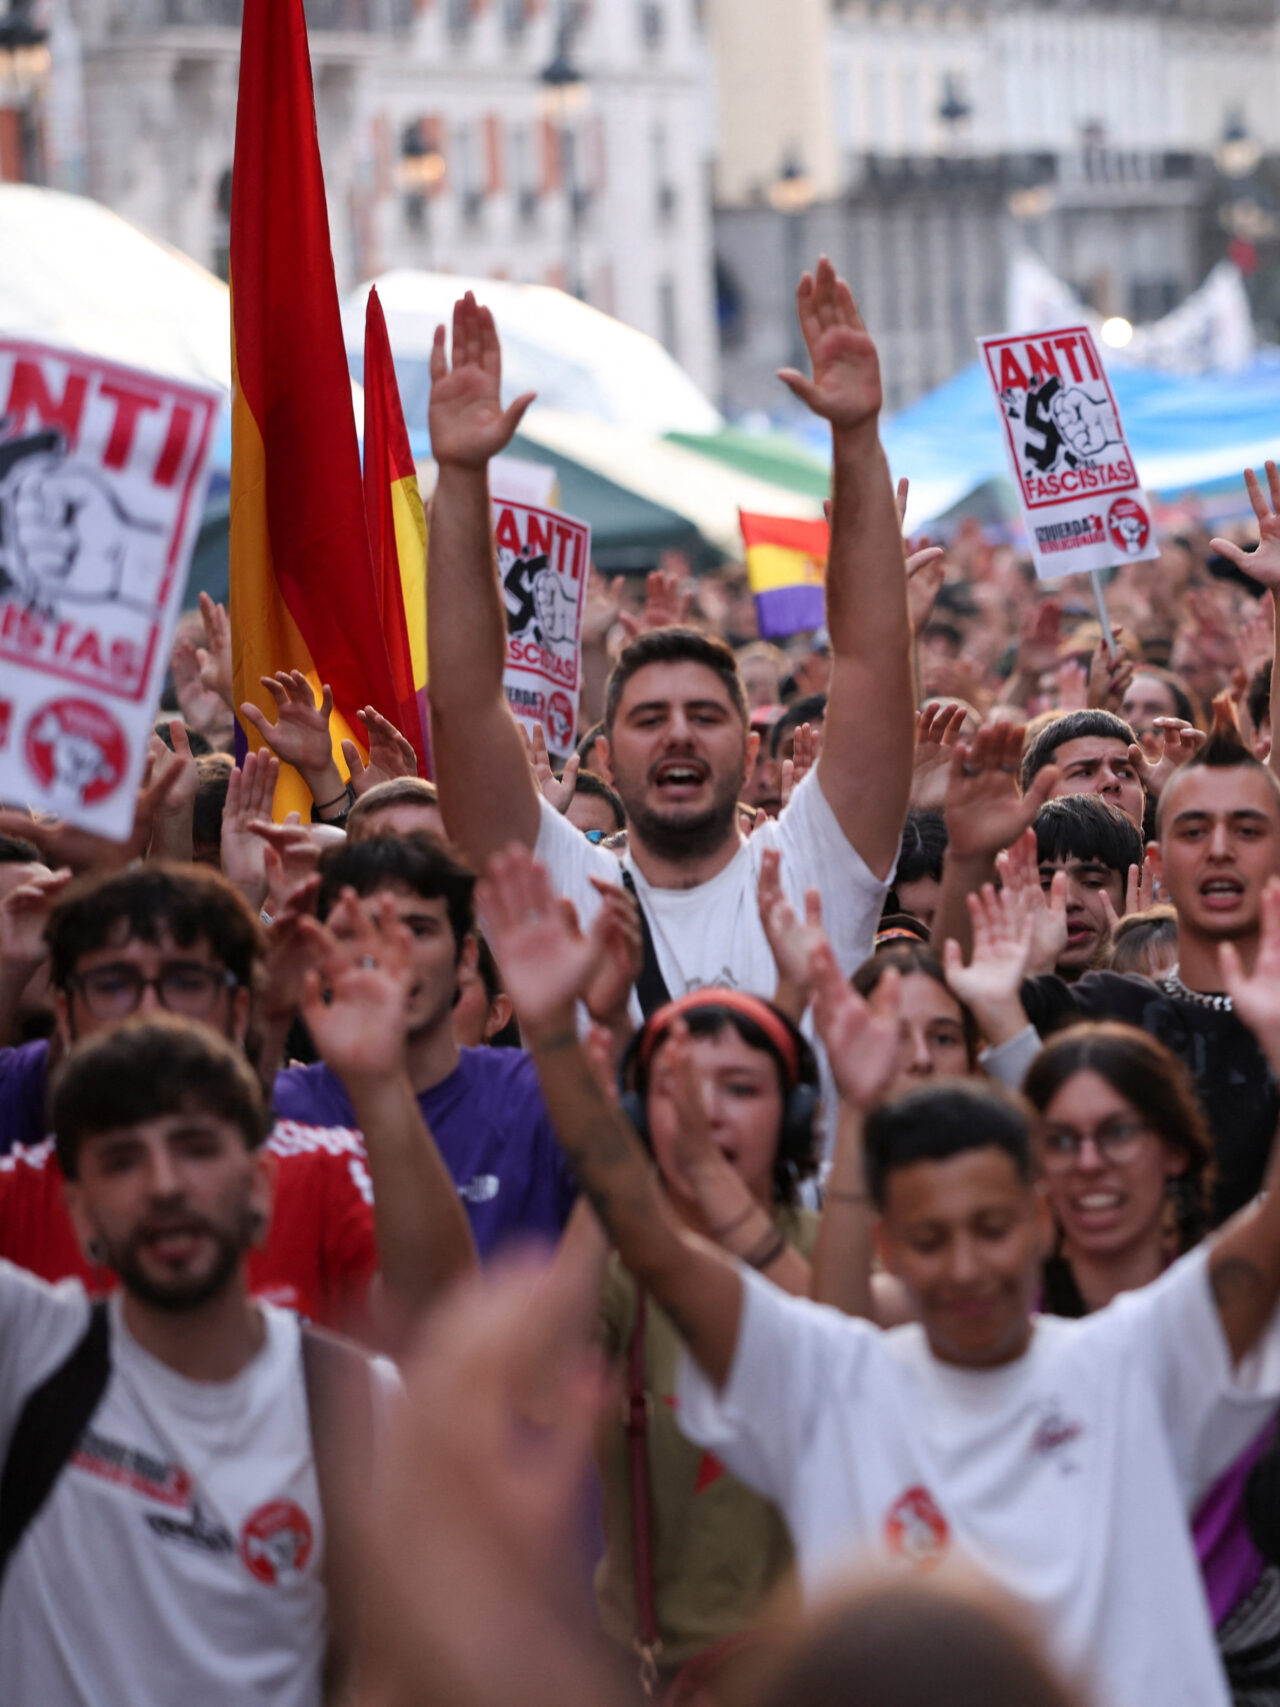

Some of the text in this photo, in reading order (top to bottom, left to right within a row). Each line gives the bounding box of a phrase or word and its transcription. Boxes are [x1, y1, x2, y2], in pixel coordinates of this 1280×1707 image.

[1001, 335, 1099, 392] ANTI
[1025, 460, 1131, 499] FASCISTAS
[495, 508, 582, 580] ANTI
